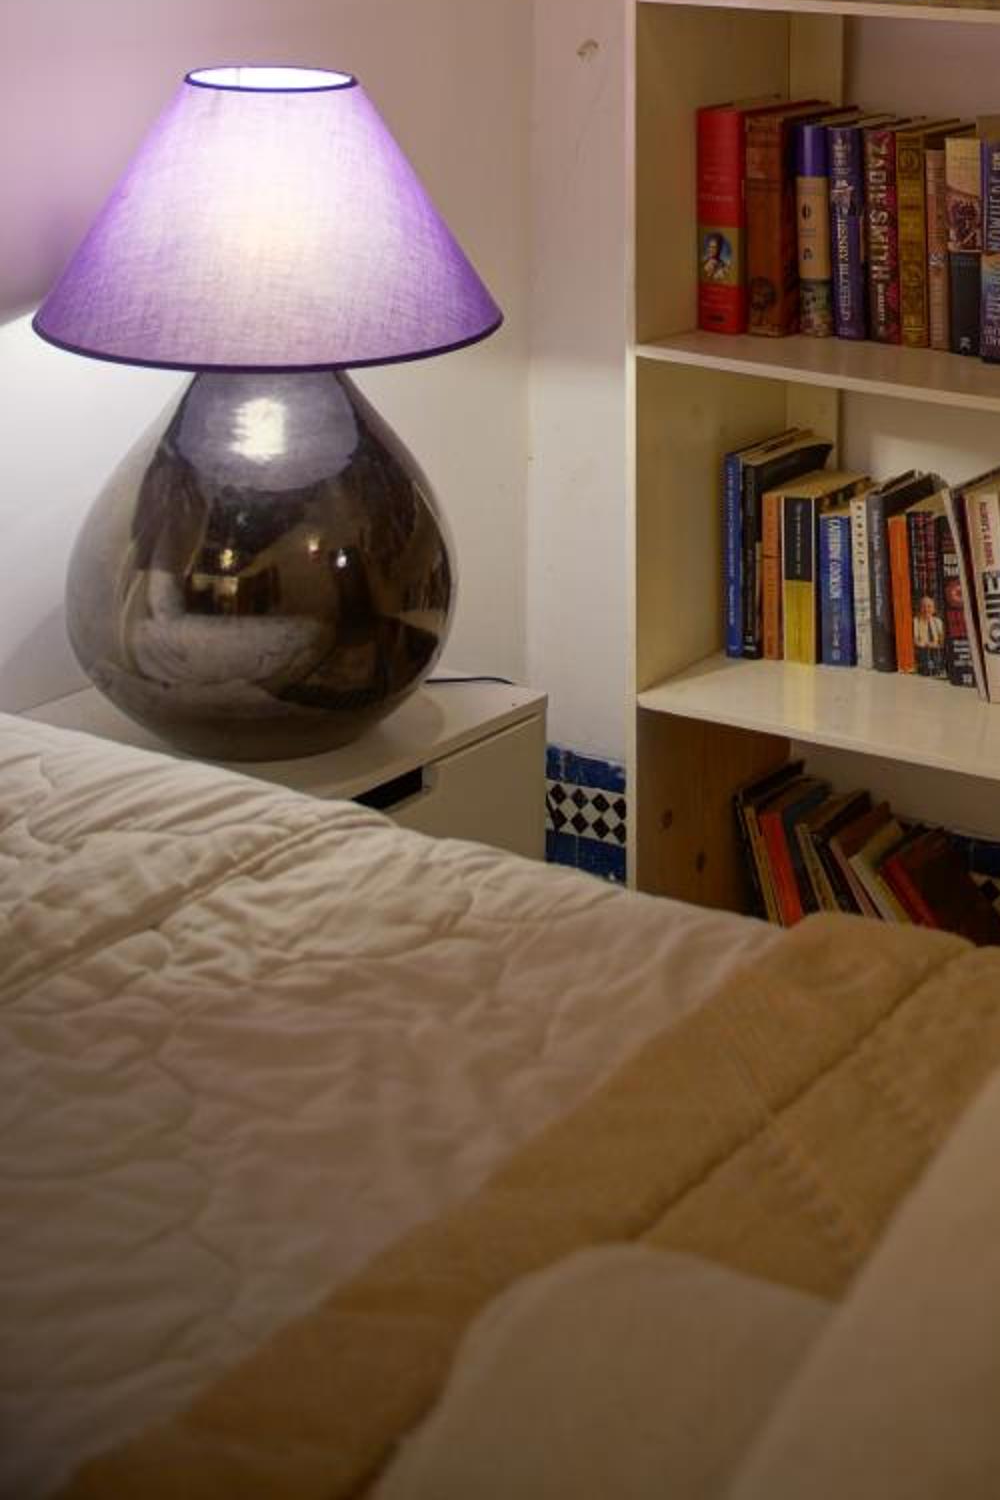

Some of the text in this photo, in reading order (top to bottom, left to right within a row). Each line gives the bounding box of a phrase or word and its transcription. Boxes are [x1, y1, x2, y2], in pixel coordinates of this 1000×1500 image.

[867, 142, 887, 204] ZADIE
[835, 218, 849, 261] HENRY
[868, 209, 890, 280] SMITH
